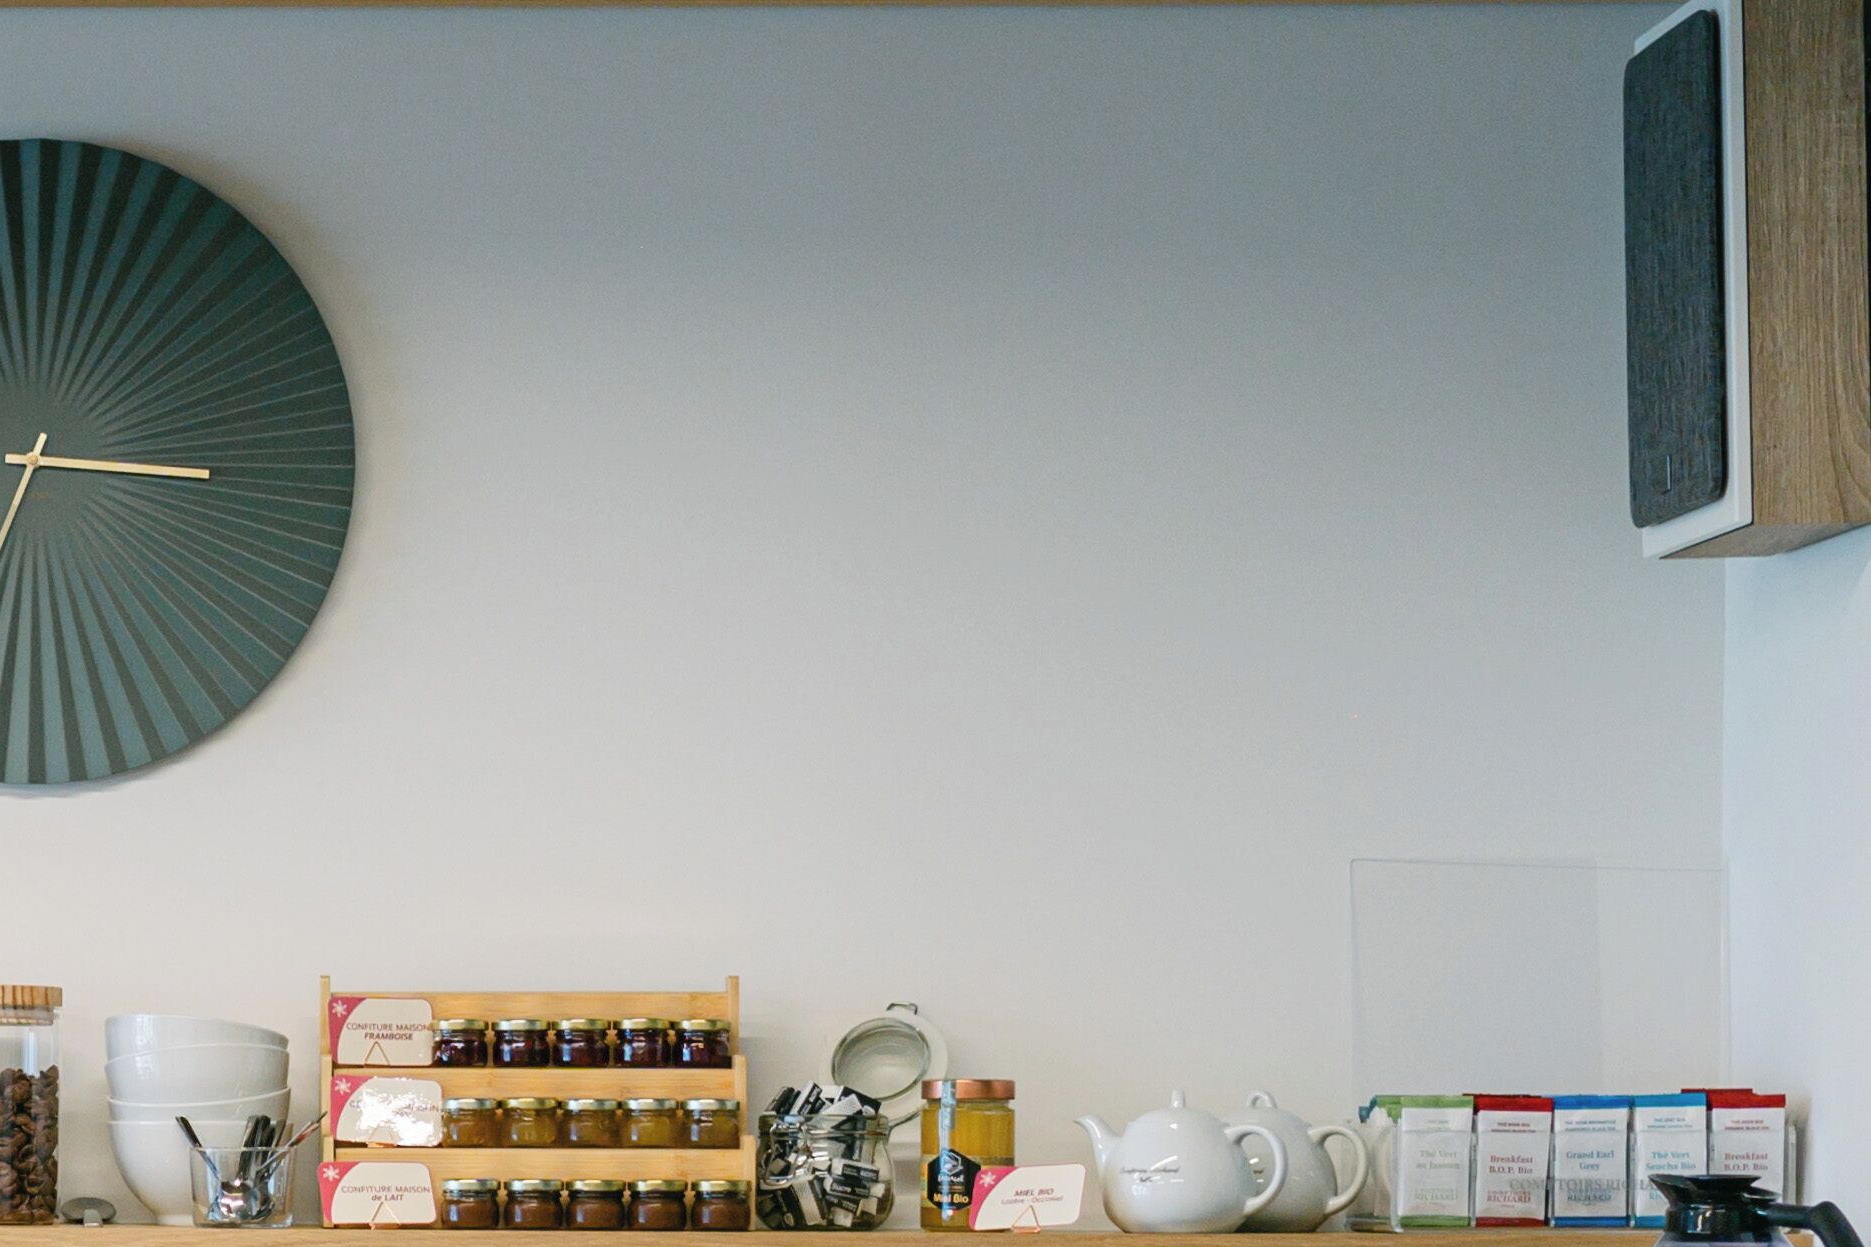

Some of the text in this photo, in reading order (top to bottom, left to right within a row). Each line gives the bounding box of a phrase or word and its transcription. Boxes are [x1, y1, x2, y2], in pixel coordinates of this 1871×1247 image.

[346, 1023, 393, 1031] CONFITURE
[364, 1032, 413, 1040] FRAMBOISE
[1438, 1150, 1457, 1158] Vert
[1566, 1150, 1614, 1159] Grand Earl
[1652, 1151, 1690, 1159] Thé Vert
[1724, 1152, 1768, 1161] Breakfast
[1490, 1155, 1533, 1164] Breakfast
[1518, 1166, 1533, 1174] Bio
[1579, 1162, 1600, 1171] Grey
[1645, 1162, 1696, 1170] Sencha Bio
[1753, 1163, 1768, 1171] Bio
[341, 1185, 431, 1193] CONFITURE MAISON
[1014, 1189, 1034, 1197] MIEL
[953, 1193, 969, 1203] Bio
